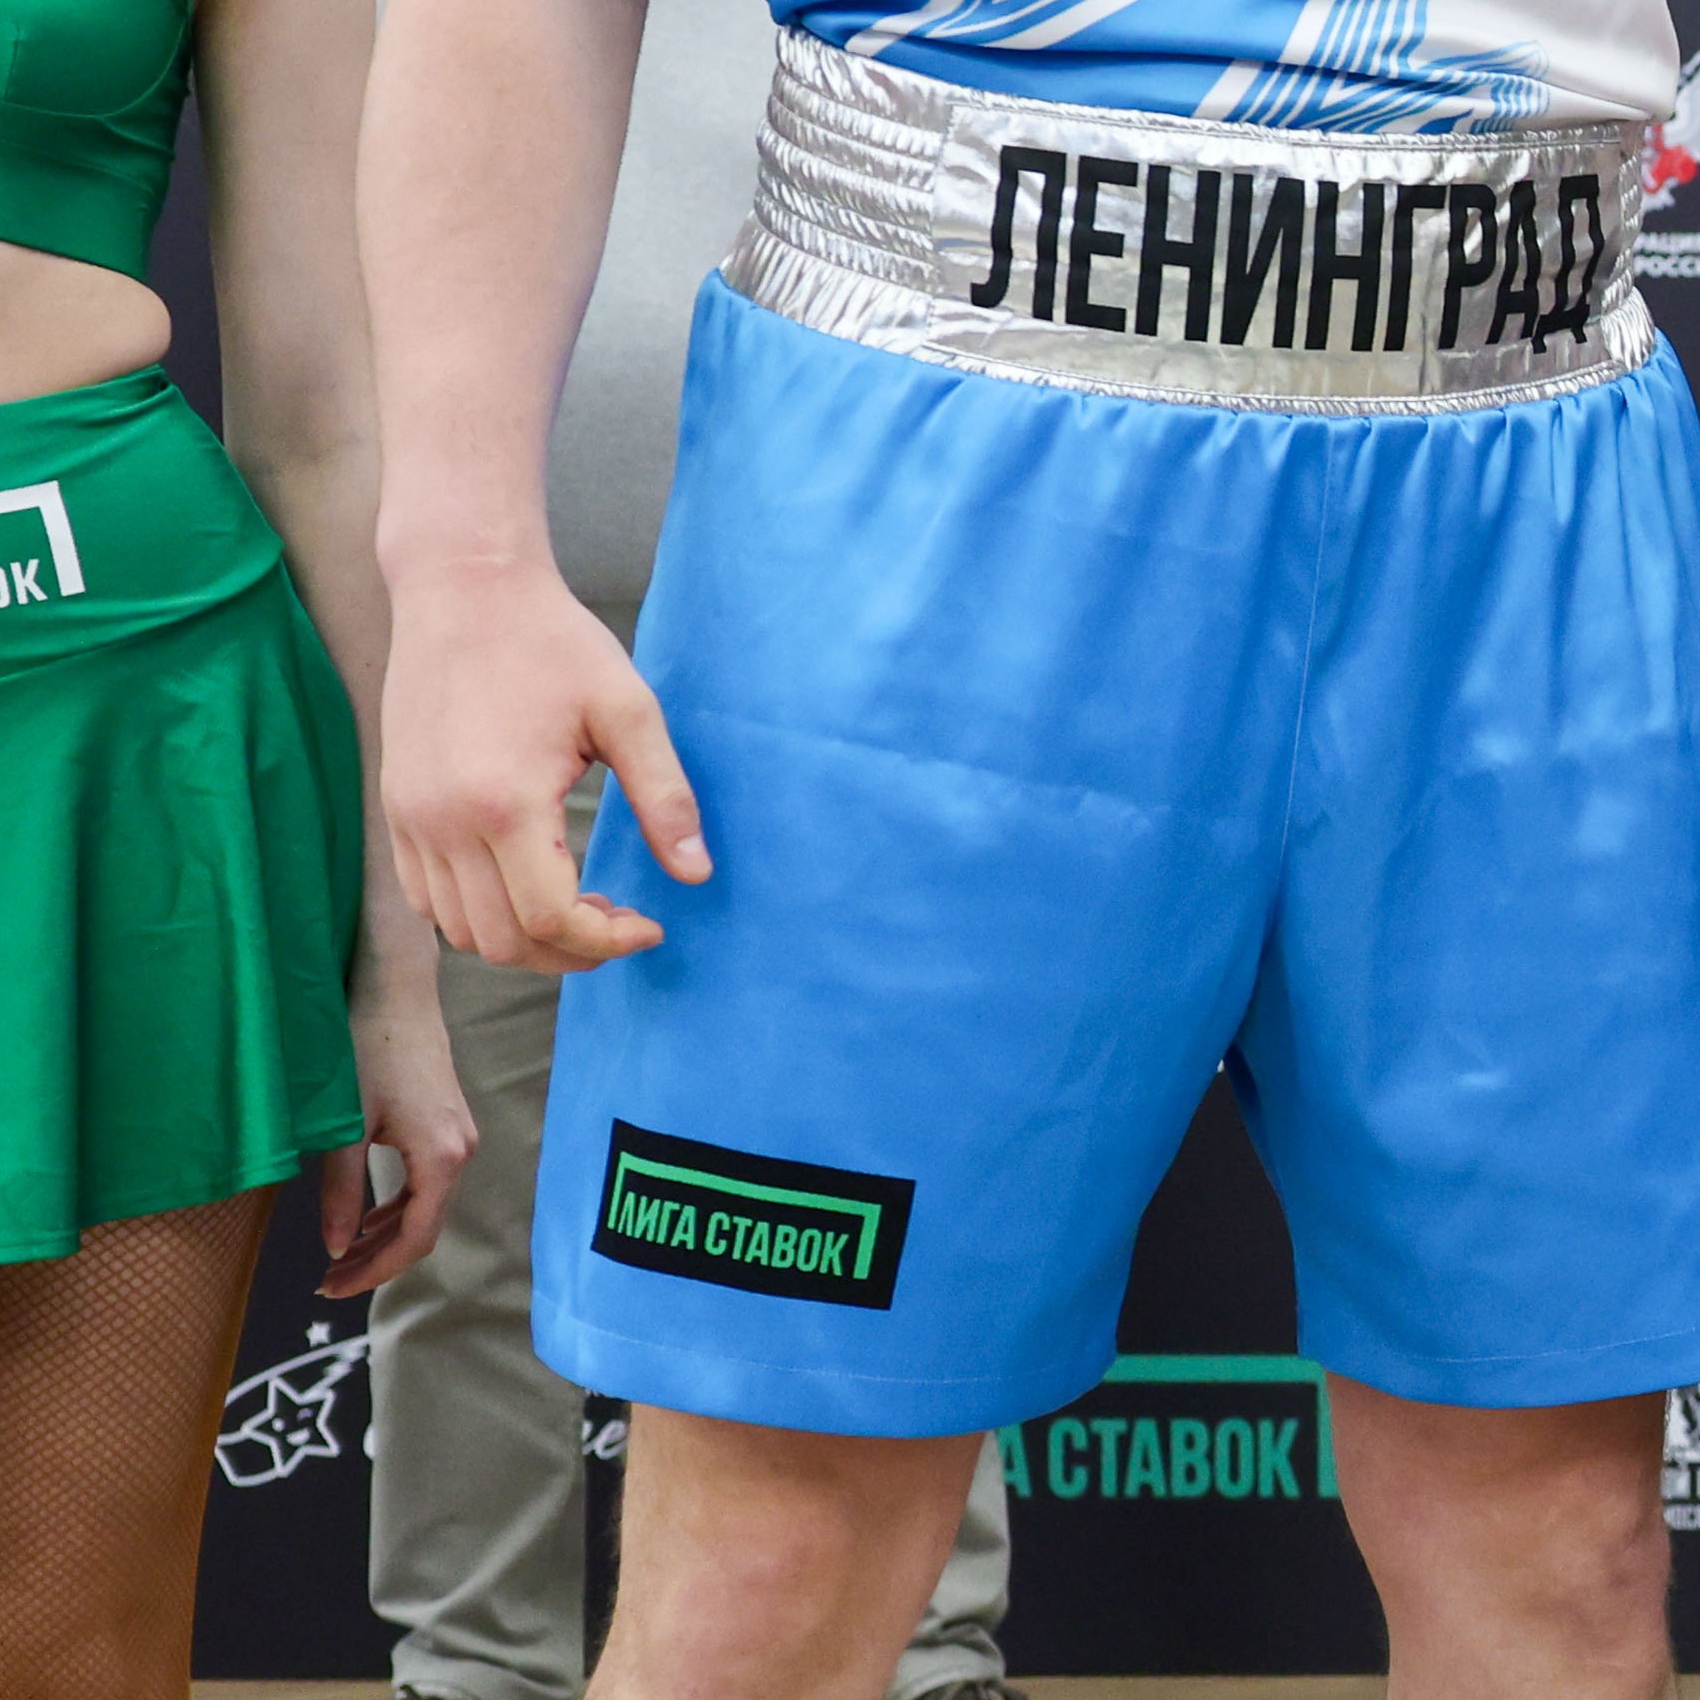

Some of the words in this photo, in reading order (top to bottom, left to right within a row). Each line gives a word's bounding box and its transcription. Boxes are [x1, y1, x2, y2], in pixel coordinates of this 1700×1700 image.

[971, 144, 1604, 354] ЛЕНИНГРАД
[617, 1190, 697, 1251] ЛИГА
[704, 1211, 849, 1277] СТАВОК
[1047, 1417, 1300, 1499] СТАВОК
